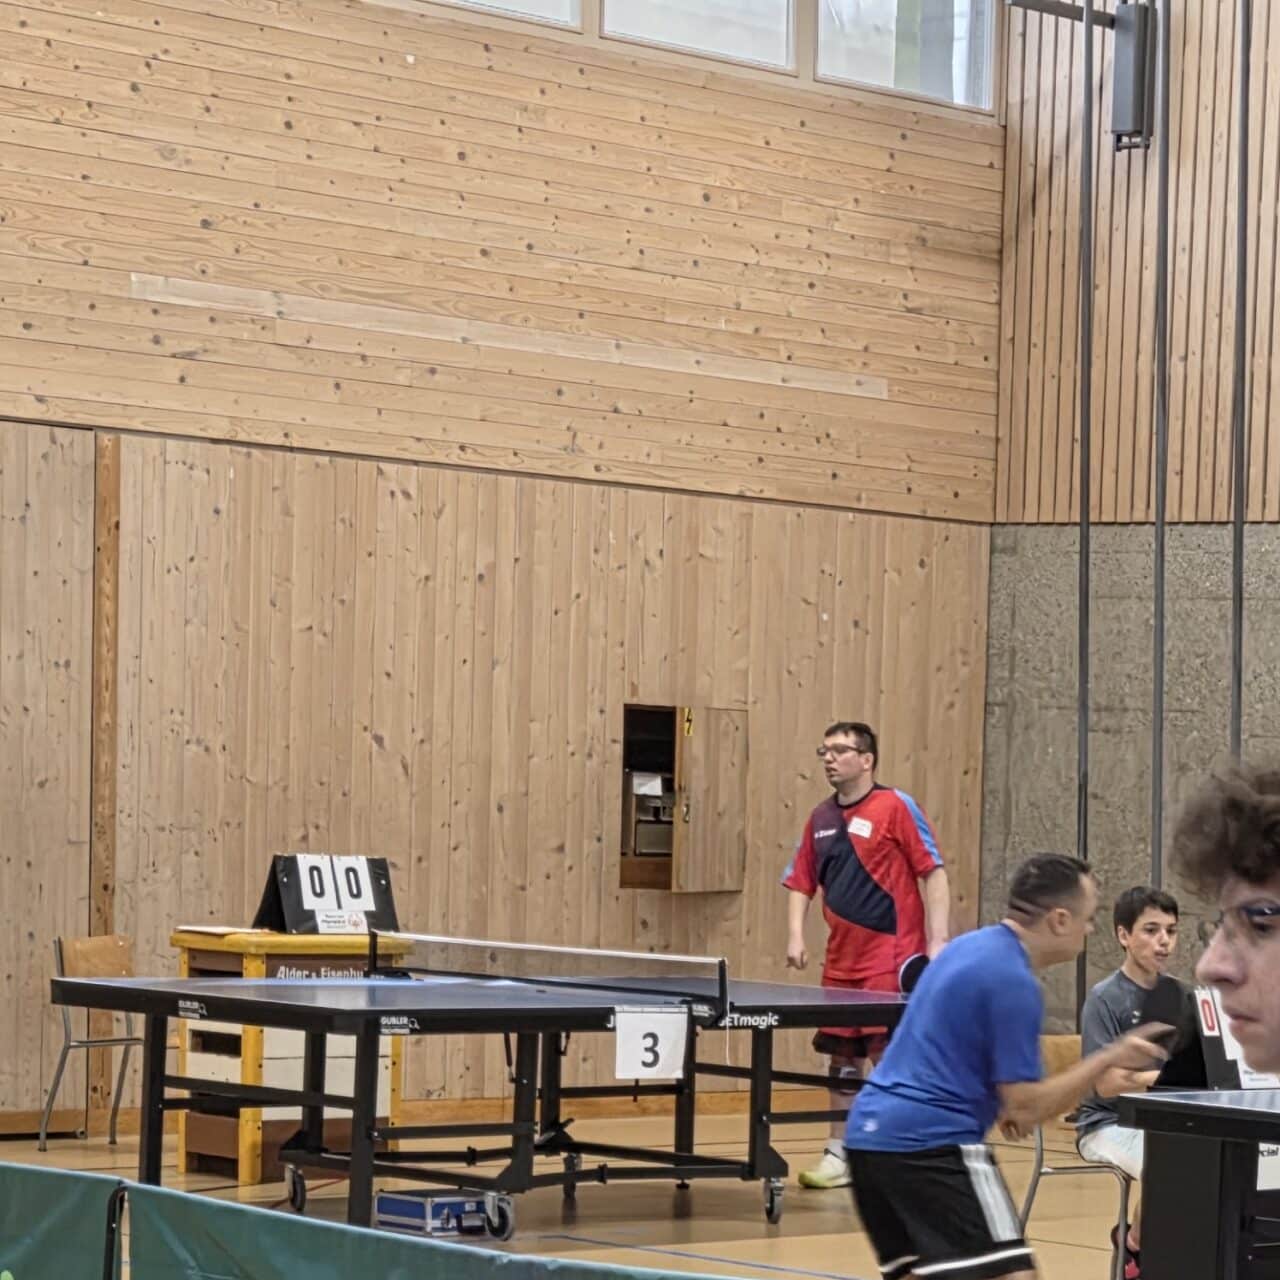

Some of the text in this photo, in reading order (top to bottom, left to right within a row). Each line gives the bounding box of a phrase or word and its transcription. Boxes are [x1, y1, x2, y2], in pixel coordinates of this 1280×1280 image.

[308, 865, 362, 900] 0 0
[320, 966, 368, 980] Eisenhu
[1201, 998, 1216, 1032] 0
[641, 1031, 661, 1069] 3
